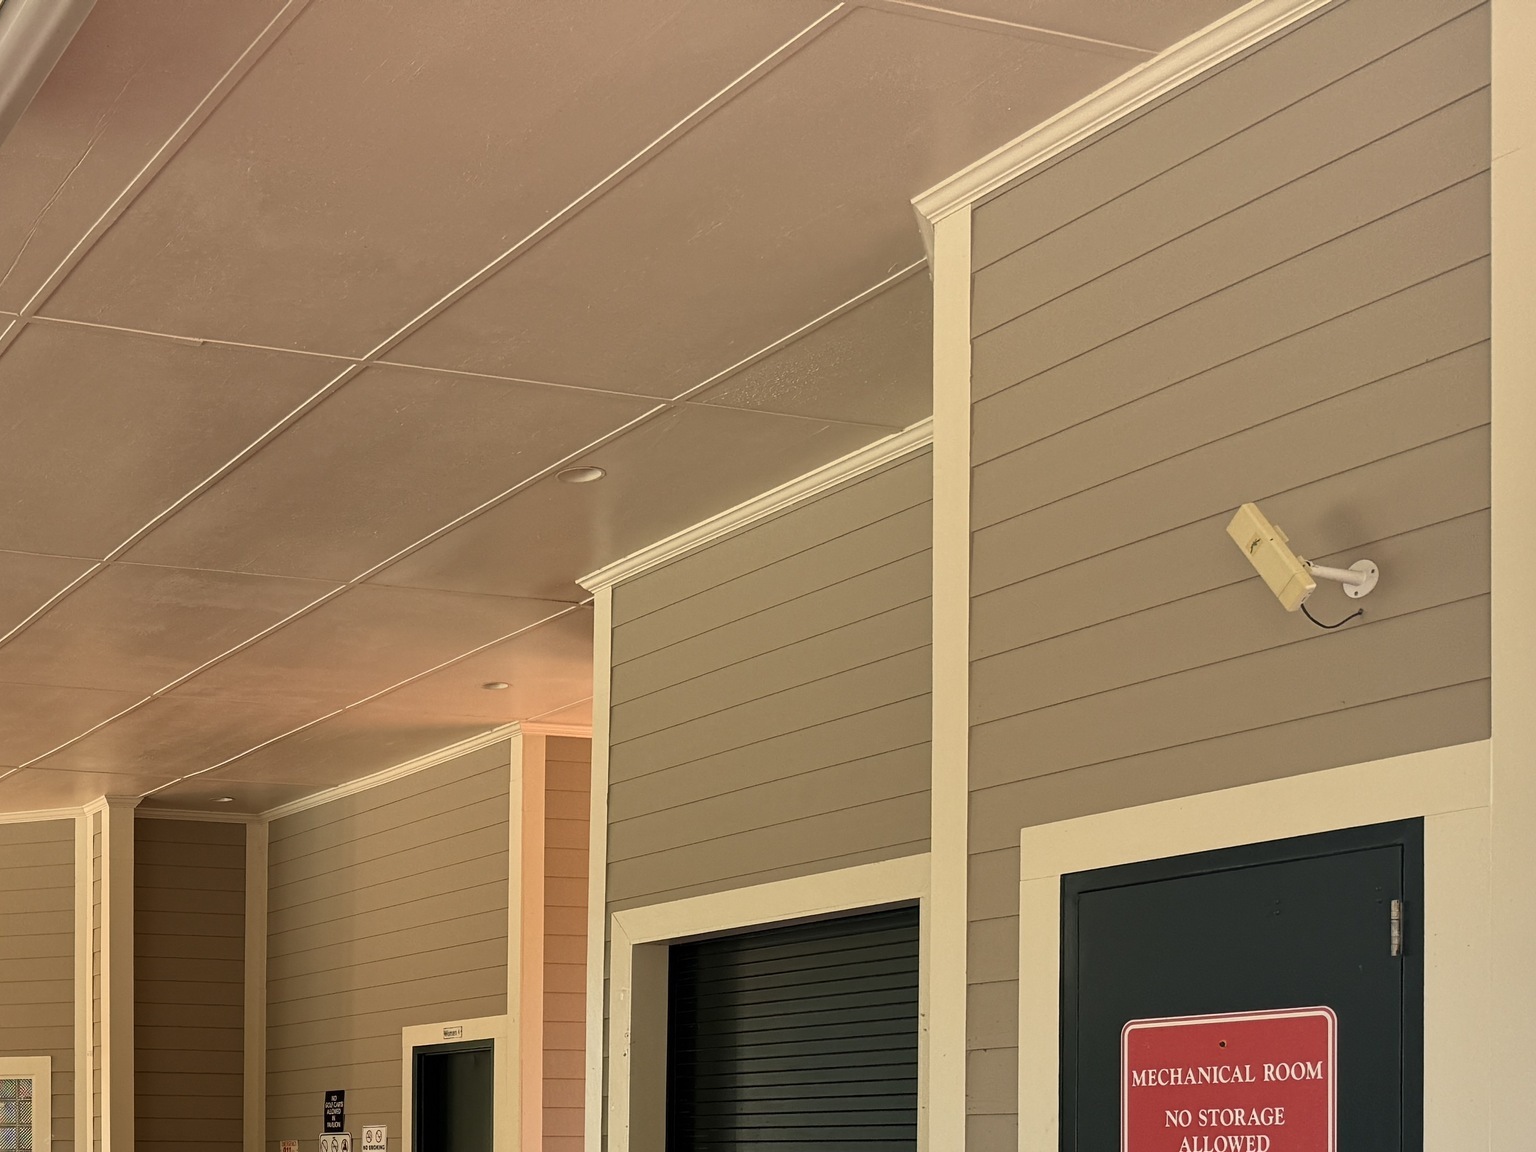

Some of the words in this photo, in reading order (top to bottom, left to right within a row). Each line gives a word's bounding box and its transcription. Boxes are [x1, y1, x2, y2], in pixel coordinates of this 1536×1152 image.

[1131, 1064, 1256, 1087] MECHANICAL
[1263, 1060, 1324, 1082] ROOM
[1164, 1109, 1192, 1128] NO
[1198, 1106, 1286, 1127] STORAGE
